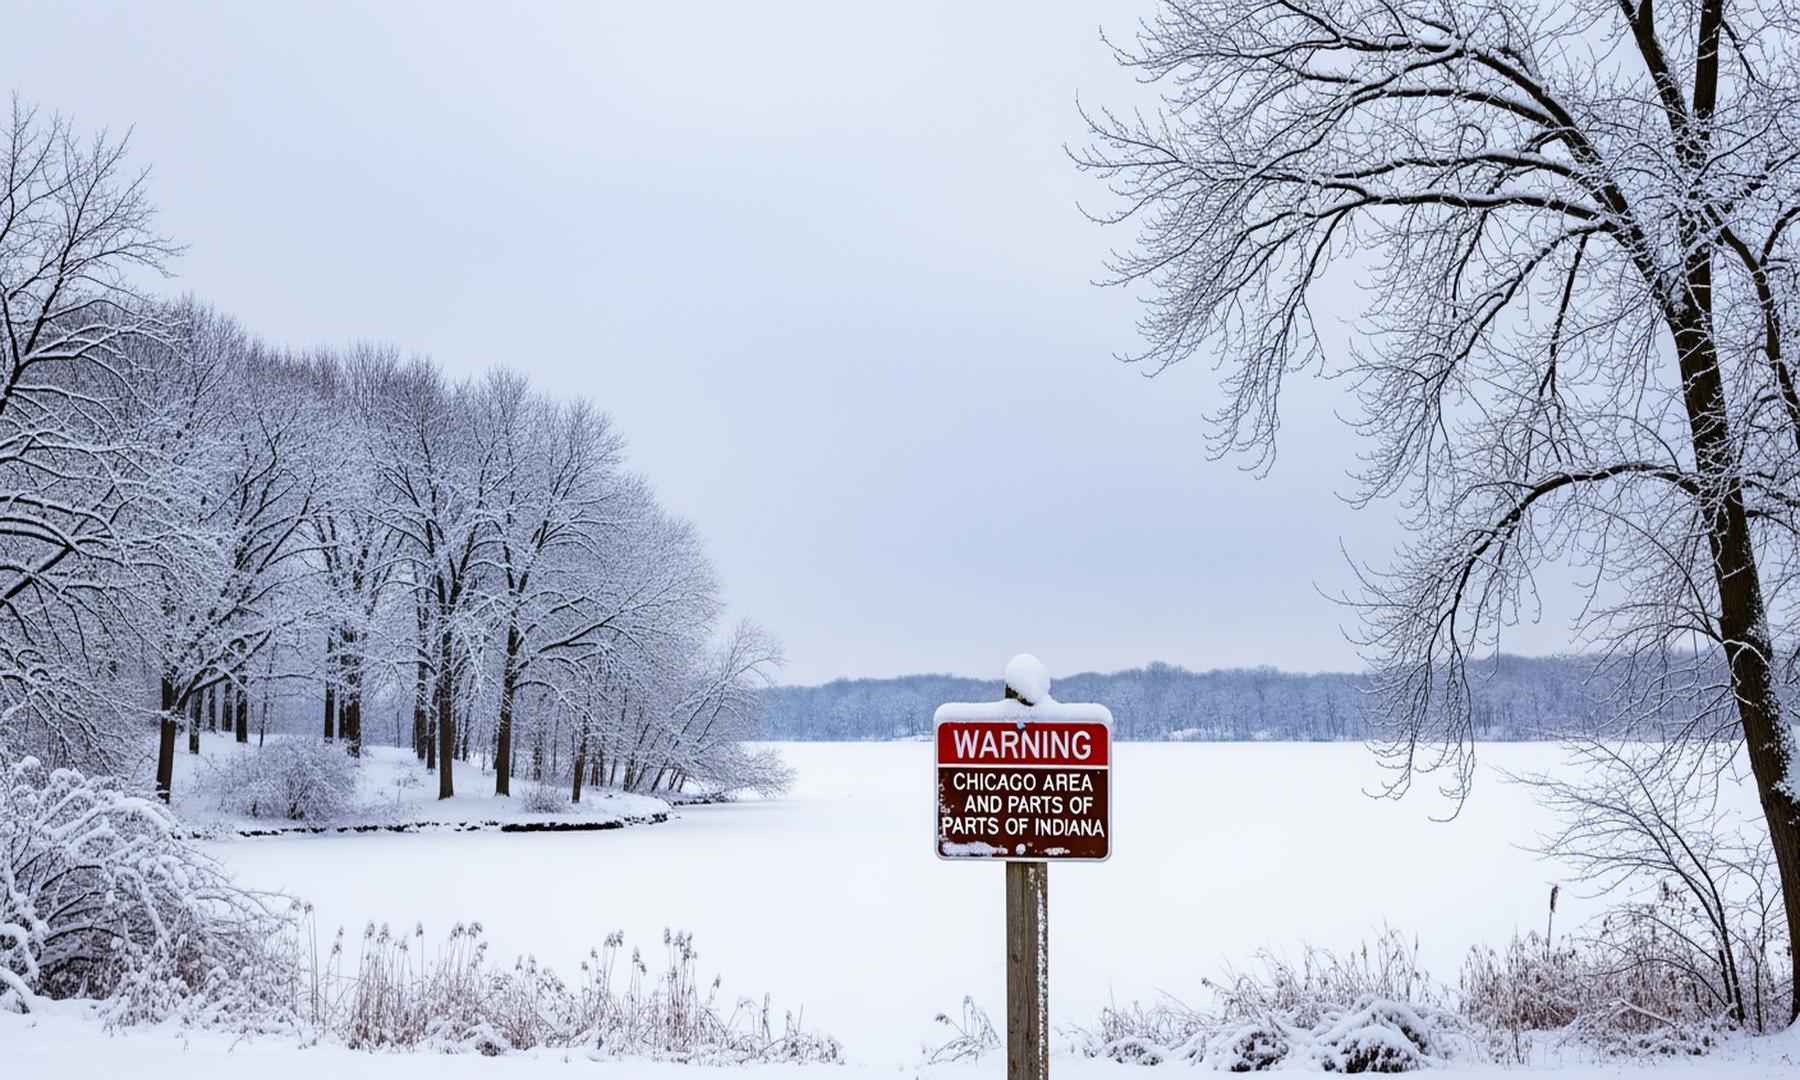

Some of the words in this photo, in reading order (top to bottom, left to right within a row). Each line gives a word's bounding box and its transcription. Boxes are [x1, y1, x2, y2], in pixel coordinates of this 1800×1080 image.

[953, 729, 1092, 760] WARNING
[953, 772, 1036, 791] CHICAGO
[1042, 773, 1094, 792] AREA
[964, 795, 1003, 814] AND
[1008, 795, 1064, 814] PARTS
[1069, 796, 1094, 815] OF
[942, 817, 999, 836] PARTS
[1004, 817, 1029, 836] OF
[1035, 818, 1105, 837] INDIANA
